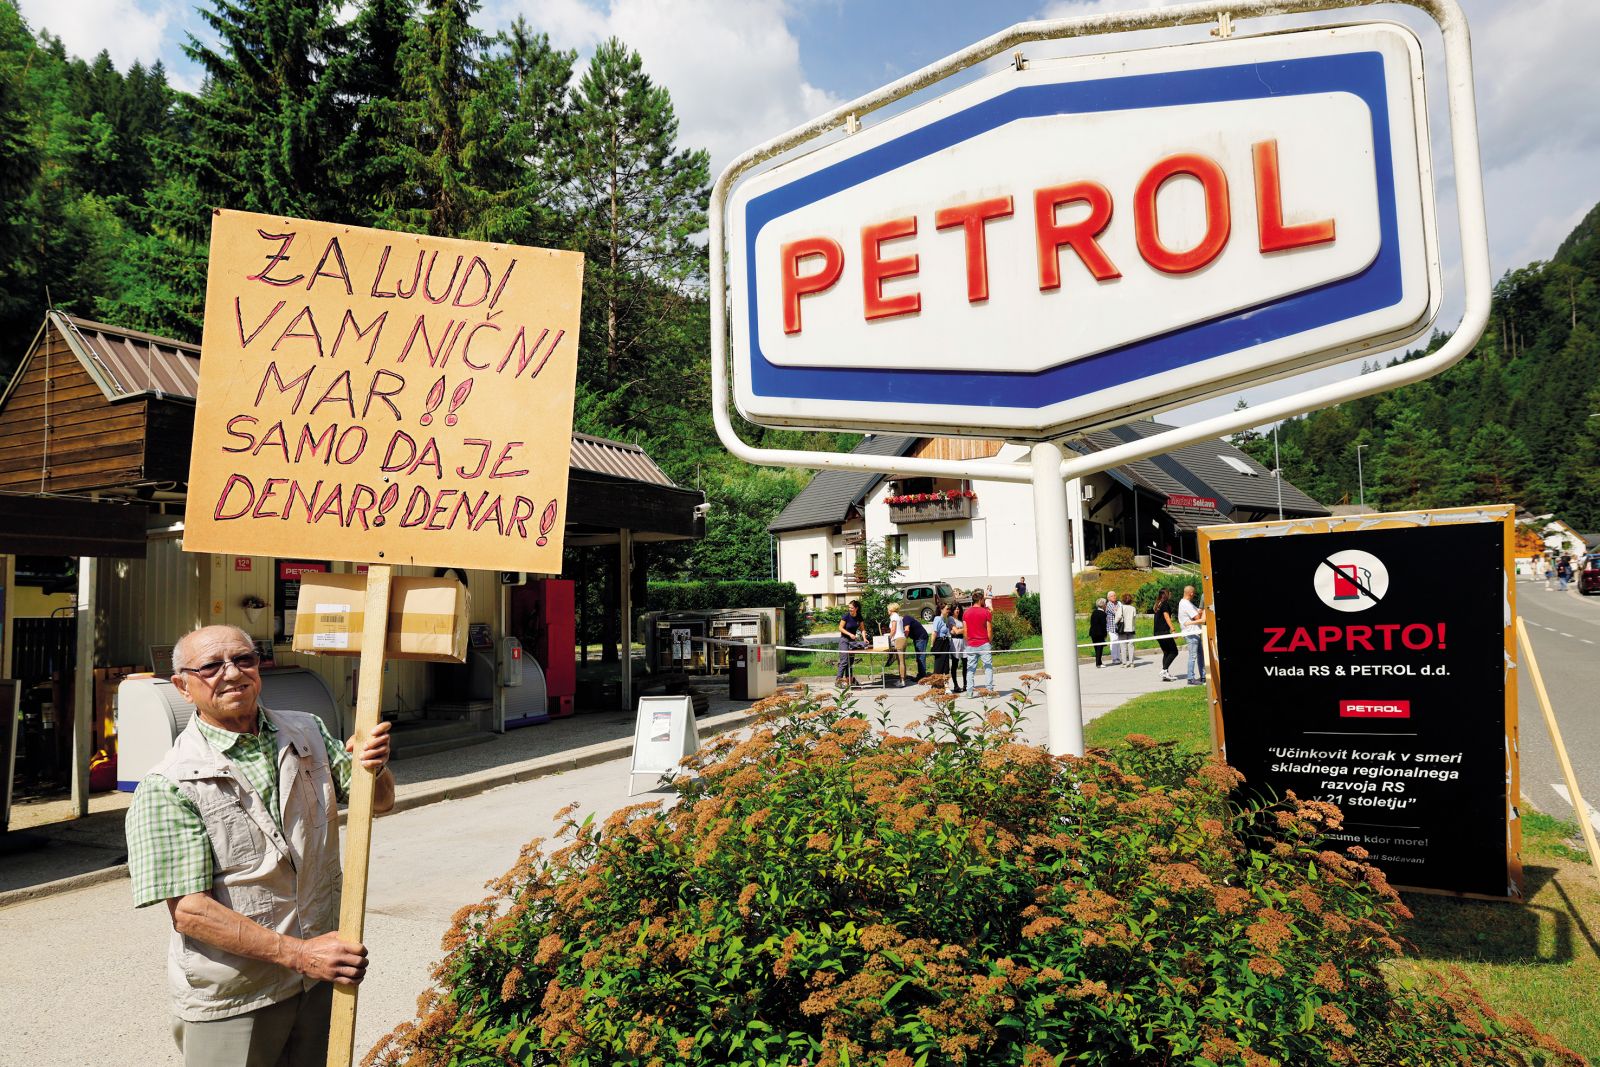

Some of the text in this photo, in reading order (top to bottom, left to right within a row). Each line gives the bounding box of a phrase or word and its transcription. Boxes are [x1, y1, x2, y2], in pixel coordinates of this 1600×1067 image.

[780, 138, 1336, 335] PETROL
[371, 245, 517, 309] LJUDI
[235, 297, 388, 364] VAM
[222, 414, 530, 480] SAMO DA JE
[1263, 622, 1447, 652] ZAPRTO!
[1264, 664, 1451, 676] Vlada RS & PETROL d.d.
[1346, 705, 1403, 713] PETROL
[1351, 749, 1396, 761] korak
[1400, 753, 1411, 762] v
[1415, 752, 1463, 764] smeri
[1271, 762, 1459, 781] skladnega regionalnega
[1321, 779, 1405, 793] razvoja RS
[1326, 794, 1343, 805] 21
[1364, 835, 1391, 844] kdor
[1394, 837, 1428, 847] more!
